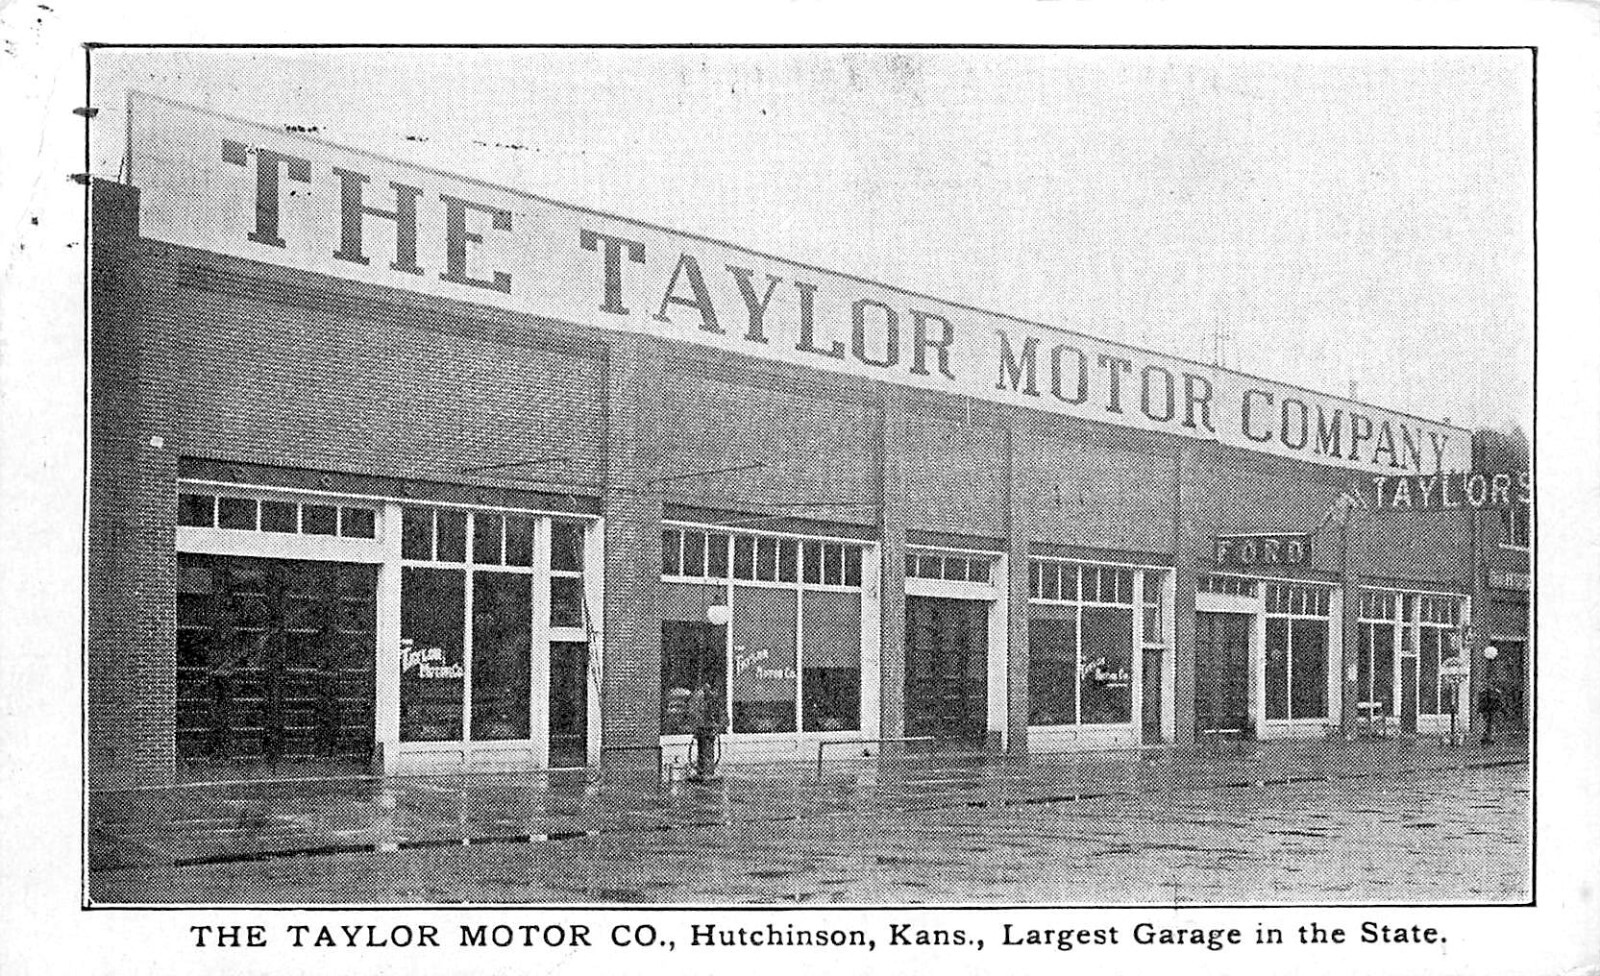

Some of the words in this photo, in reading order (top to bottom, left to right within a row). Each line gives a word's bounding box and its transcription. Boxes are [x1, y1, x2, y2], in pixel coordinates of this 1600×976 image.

[222, 139, 513, 294] THE
[579, 227, 956, 381] TAYLOR
[994, 328, 1216, 434] MOTOR
[1241, 387, 1450, 473] COMPANY
[1217, 538, 1304, 564] FORD
